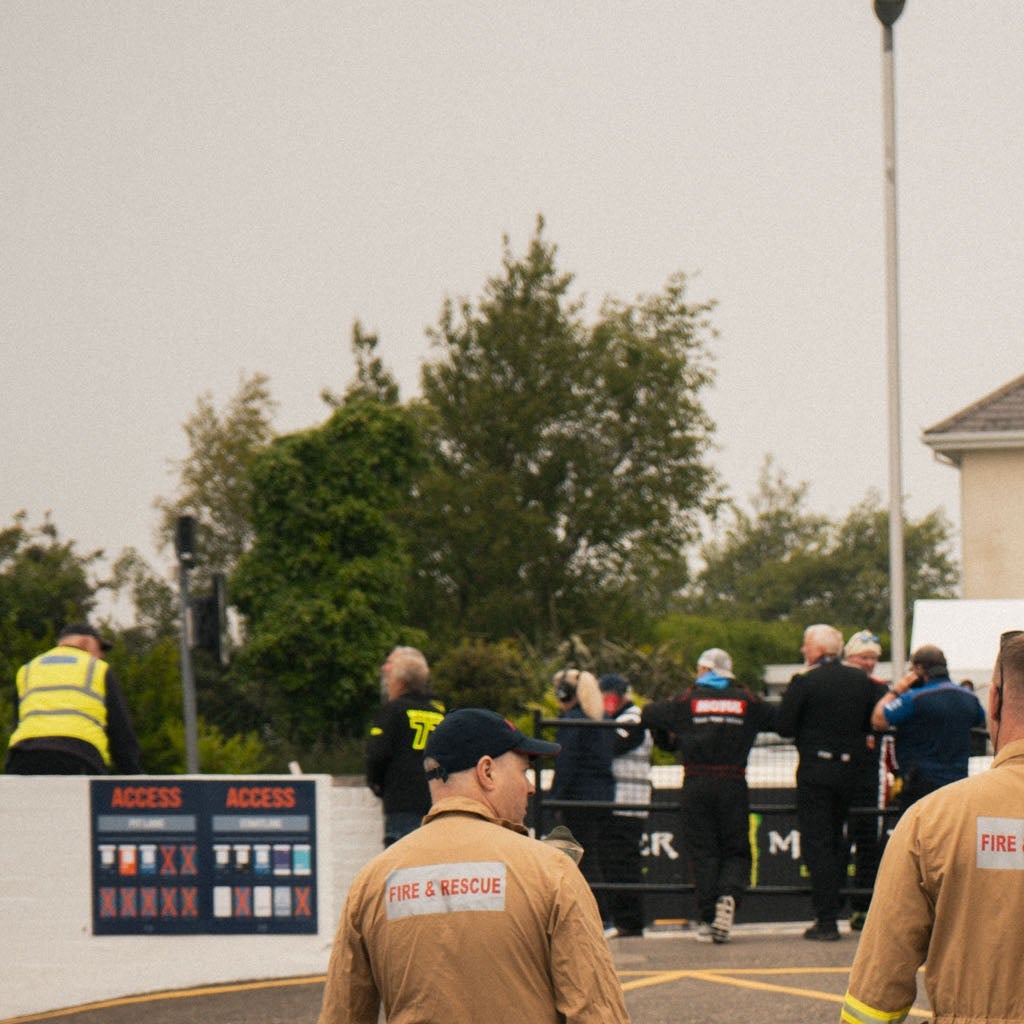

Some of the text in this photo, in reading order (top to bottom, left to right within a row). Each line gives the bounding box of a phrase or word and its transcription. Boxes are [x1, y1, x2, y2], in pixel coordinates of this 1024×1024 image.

[111, 786, 183, 809] ACCESS
[226, 786, 296, 809] ACCESS
[981, 834, 1017, 852] FIRE
[389, 877, 501, 903] FIRE & RESCUE
